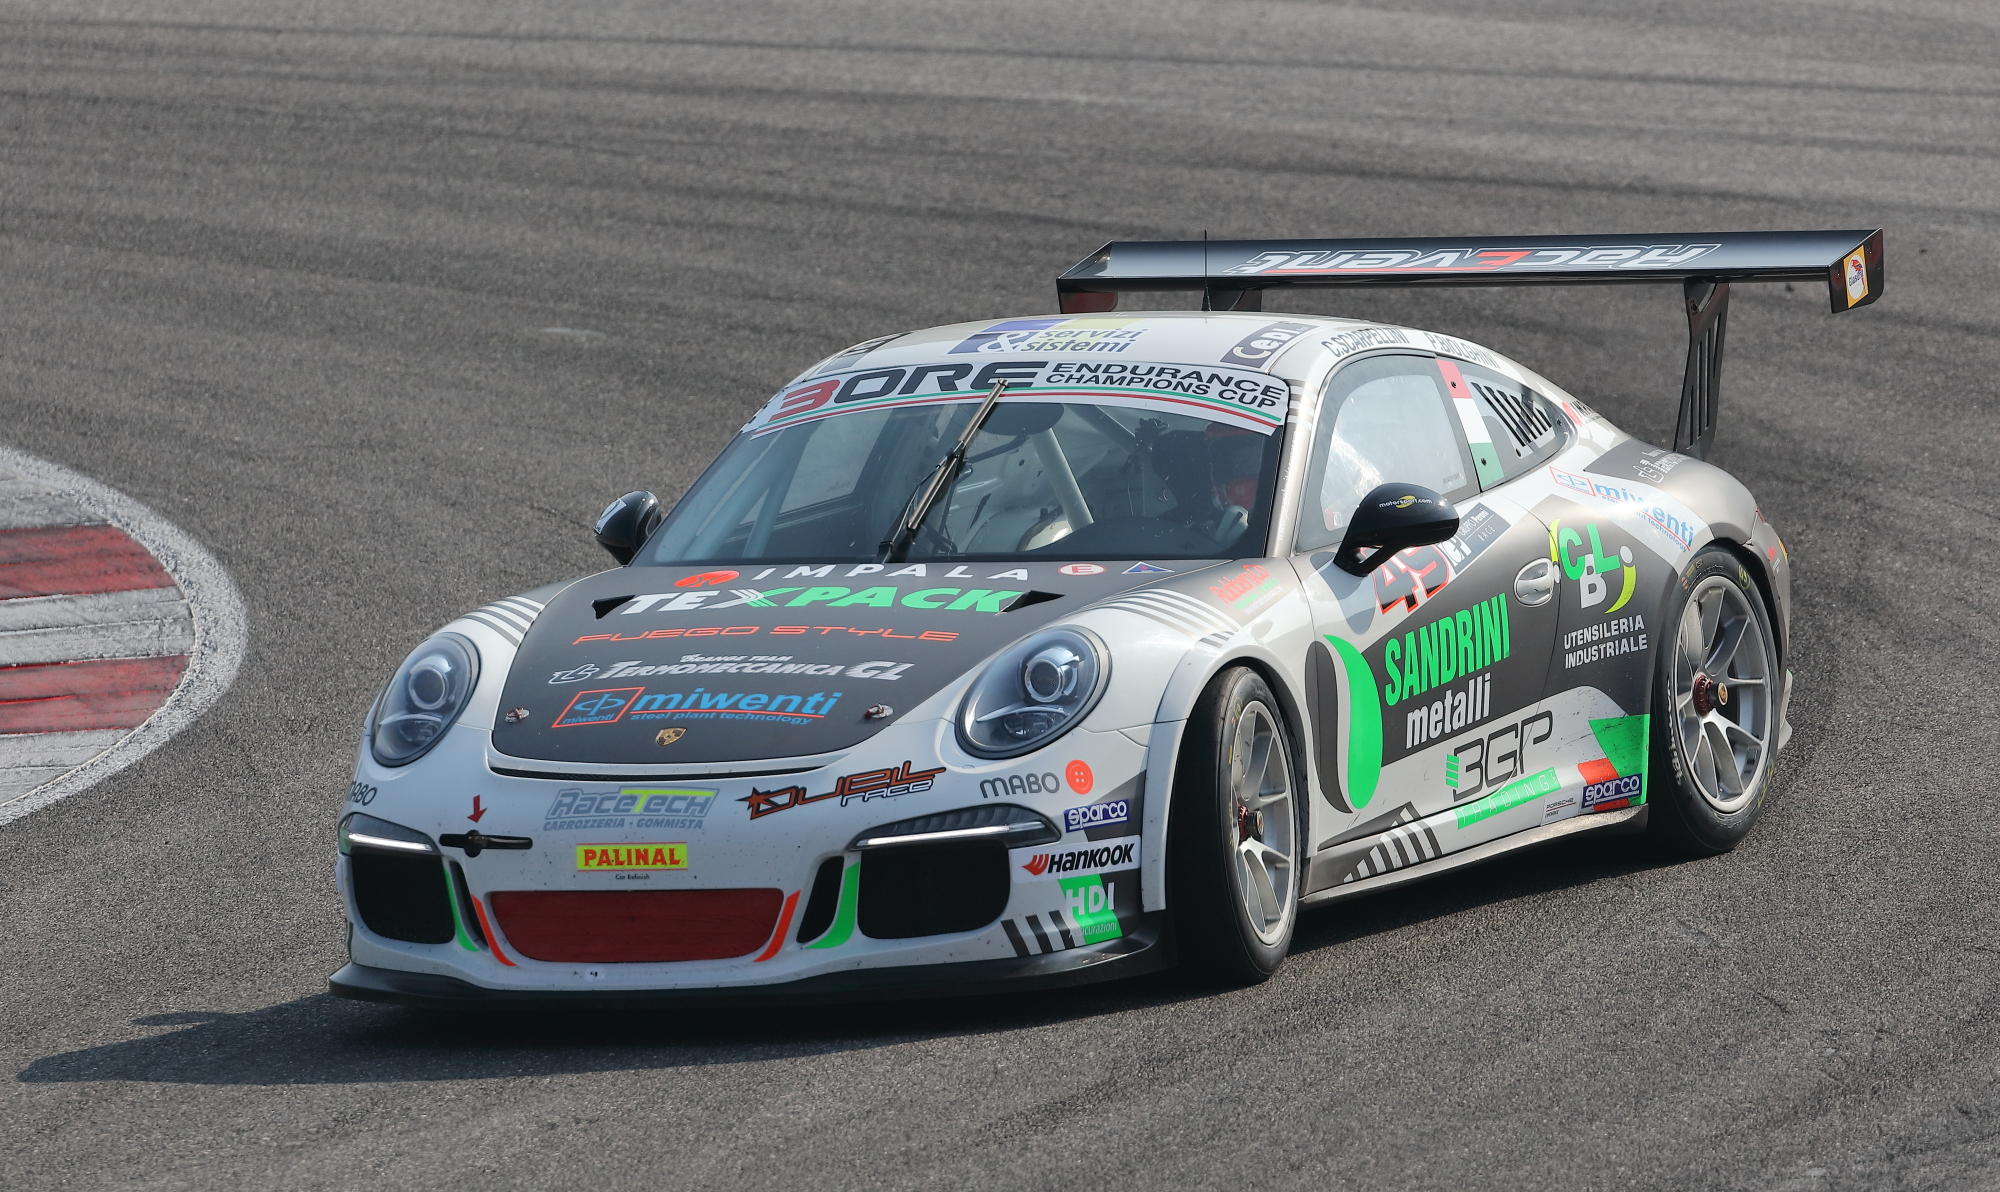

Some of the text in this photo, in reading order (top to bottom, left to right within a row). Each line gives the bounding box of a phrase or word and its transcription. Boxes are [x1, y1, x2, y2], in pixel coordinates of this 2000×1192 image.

[1020, 339, 1137, 353] sistemi
[1038, 328, 1149, 339] servizi
[1045, 373, 1278, 408] CHAMPIONS CUP
[1051, 362, 1286, 400] ENDURANCE
[1378, 496, 1433, 508] motorsport.com
[751, 565, 1029, 581] IMPALA
[620, 585, 1025, 616] TEXPACK
[572, 625, 961, 646] FUEGO STYLE
[1564, 614, 1645, 650] UTENSILERIA
[1384, 592, 1511, 707] SANDRINI
[1564, 633, 1648, 670] INDUSTRIALE
[632, 687, 843, 716] miwenti
[1405, 671, 1492, 751] metalli
[631, 711, 813, 726] steel plant technology
[979, 771, 1061, 799] MABO
[1457, 773, 1551, 825] TRADING
[1585, 774, 1641, 805] sparco
[543, 817, 703, 832] CARROZZERIA GOMMISTA
[1067, 800, 1128, 830] sparco
[583, 847, 682, 867] PALINAL
[615, 873, 651, 881] Car Refinish
[1065, 881, 1116, 918] HDI
